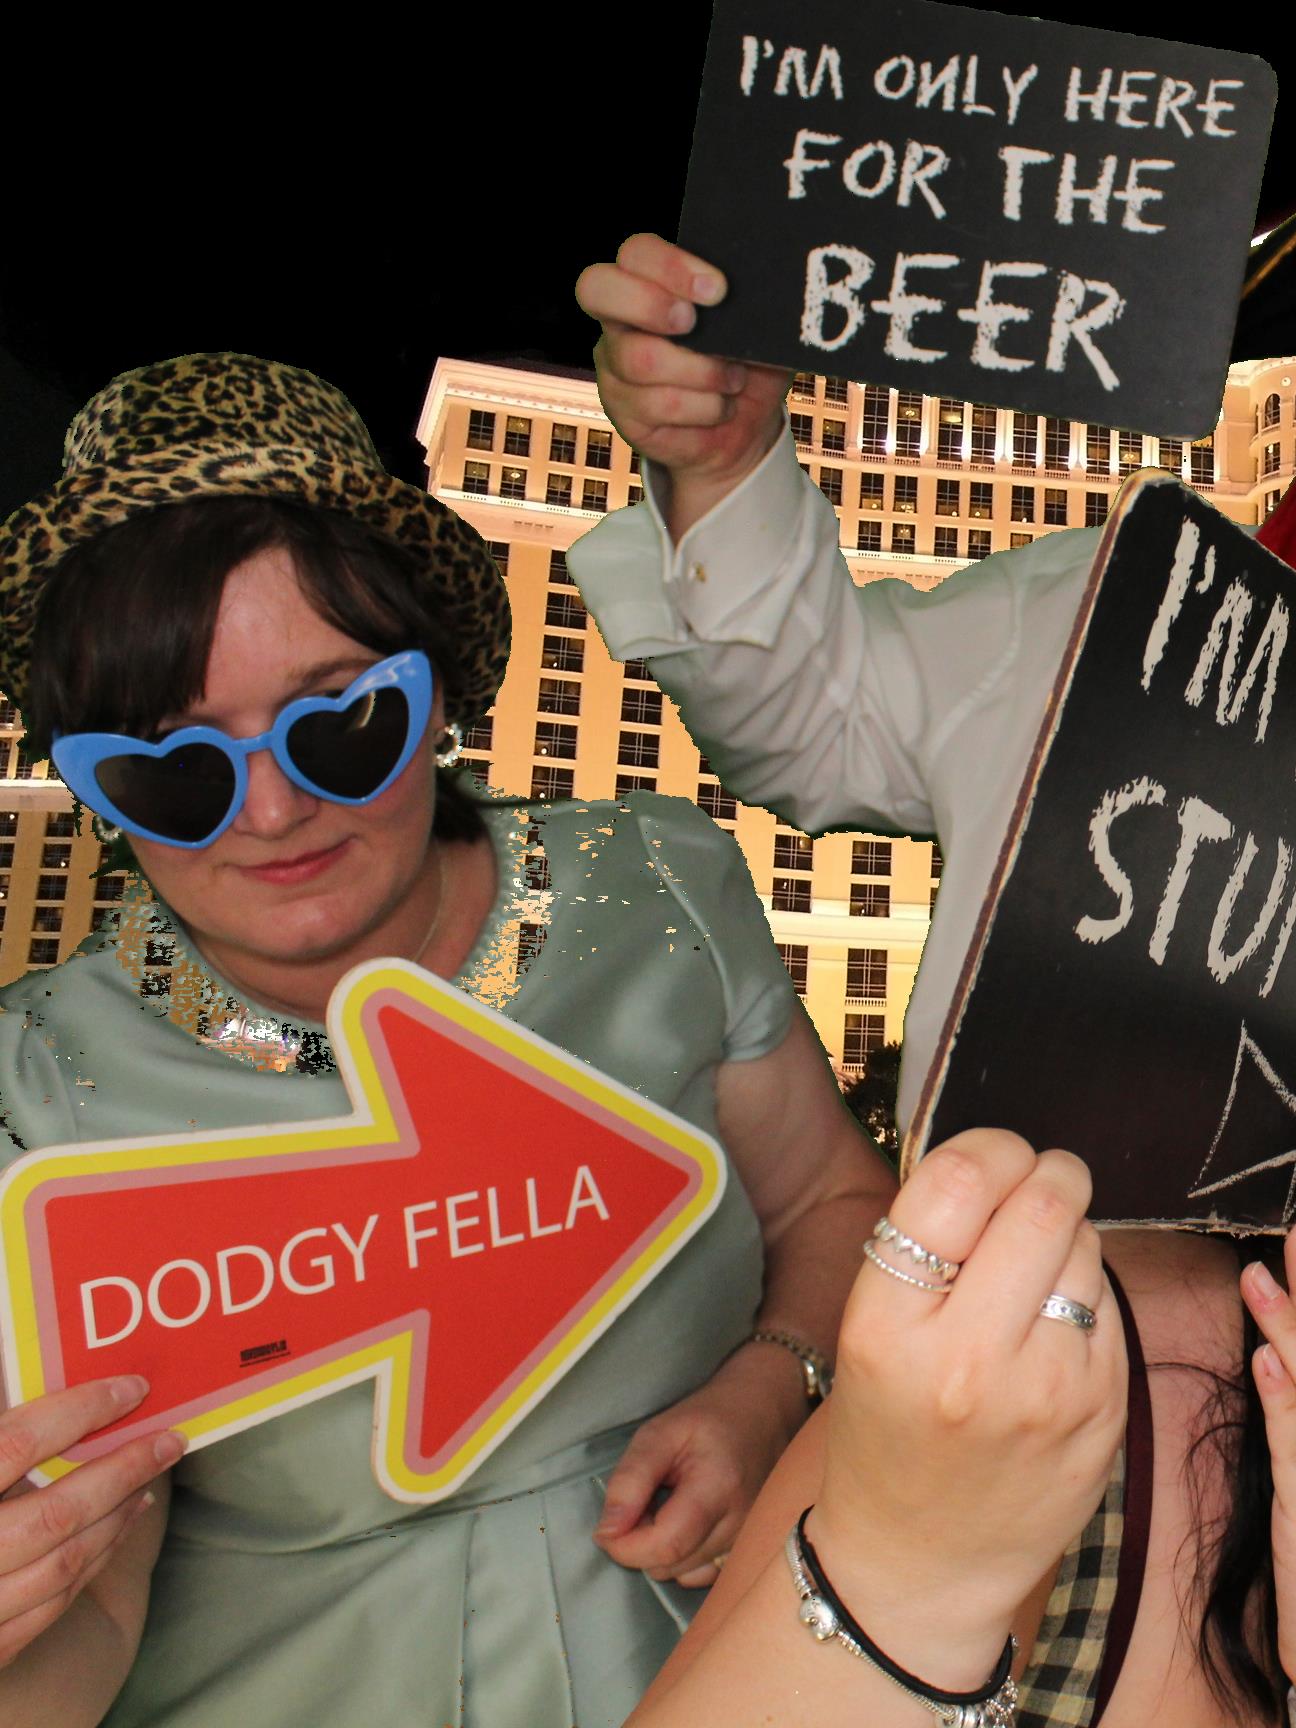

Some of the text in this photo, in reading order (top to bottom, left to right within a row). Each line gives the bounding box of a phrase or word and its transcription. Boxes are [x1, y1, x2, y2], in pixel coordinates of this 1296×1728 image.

[740, 35, 1244, 138] I'M ONLY HERE
[783, 128, 1175, 234] FOR THE
[800, 243, 1126, 391] BEER
[1141, 515, 1290, 744] I'M
[79, 1164, 609, 1350] DODGY FELLA
